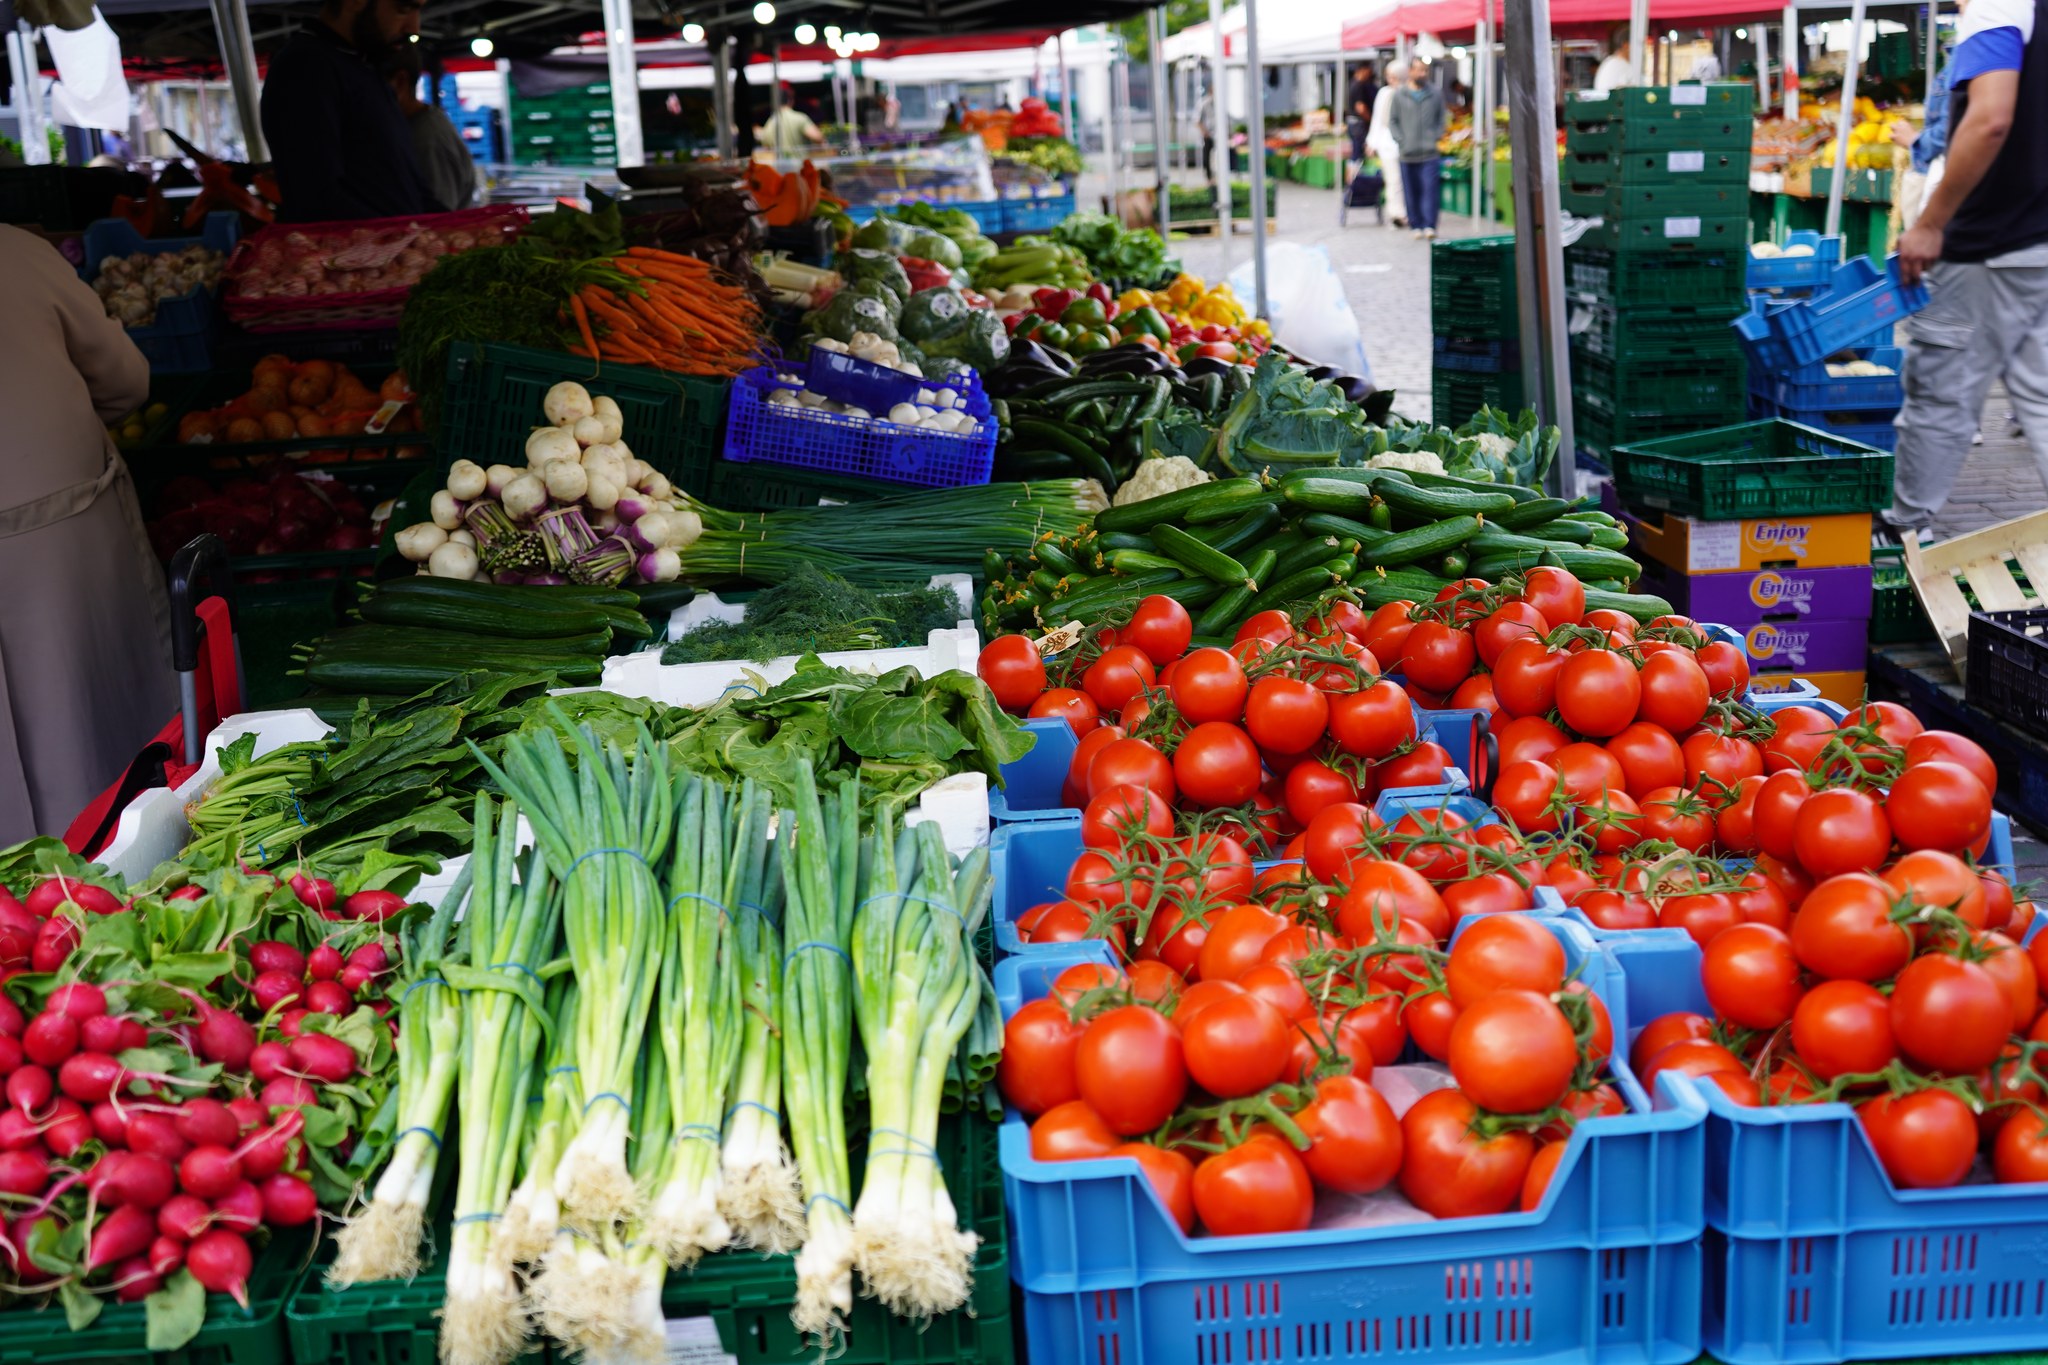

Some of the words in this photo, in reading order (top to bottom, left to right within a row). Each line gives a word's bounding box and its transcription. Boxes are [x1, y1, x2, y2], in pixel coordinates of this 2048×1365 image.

[1754, 521, 1811, 543] Enjoy
[1758, 577, 1814, 597] Enjoy
[1754, 629, 1809, 649] Enjoy
